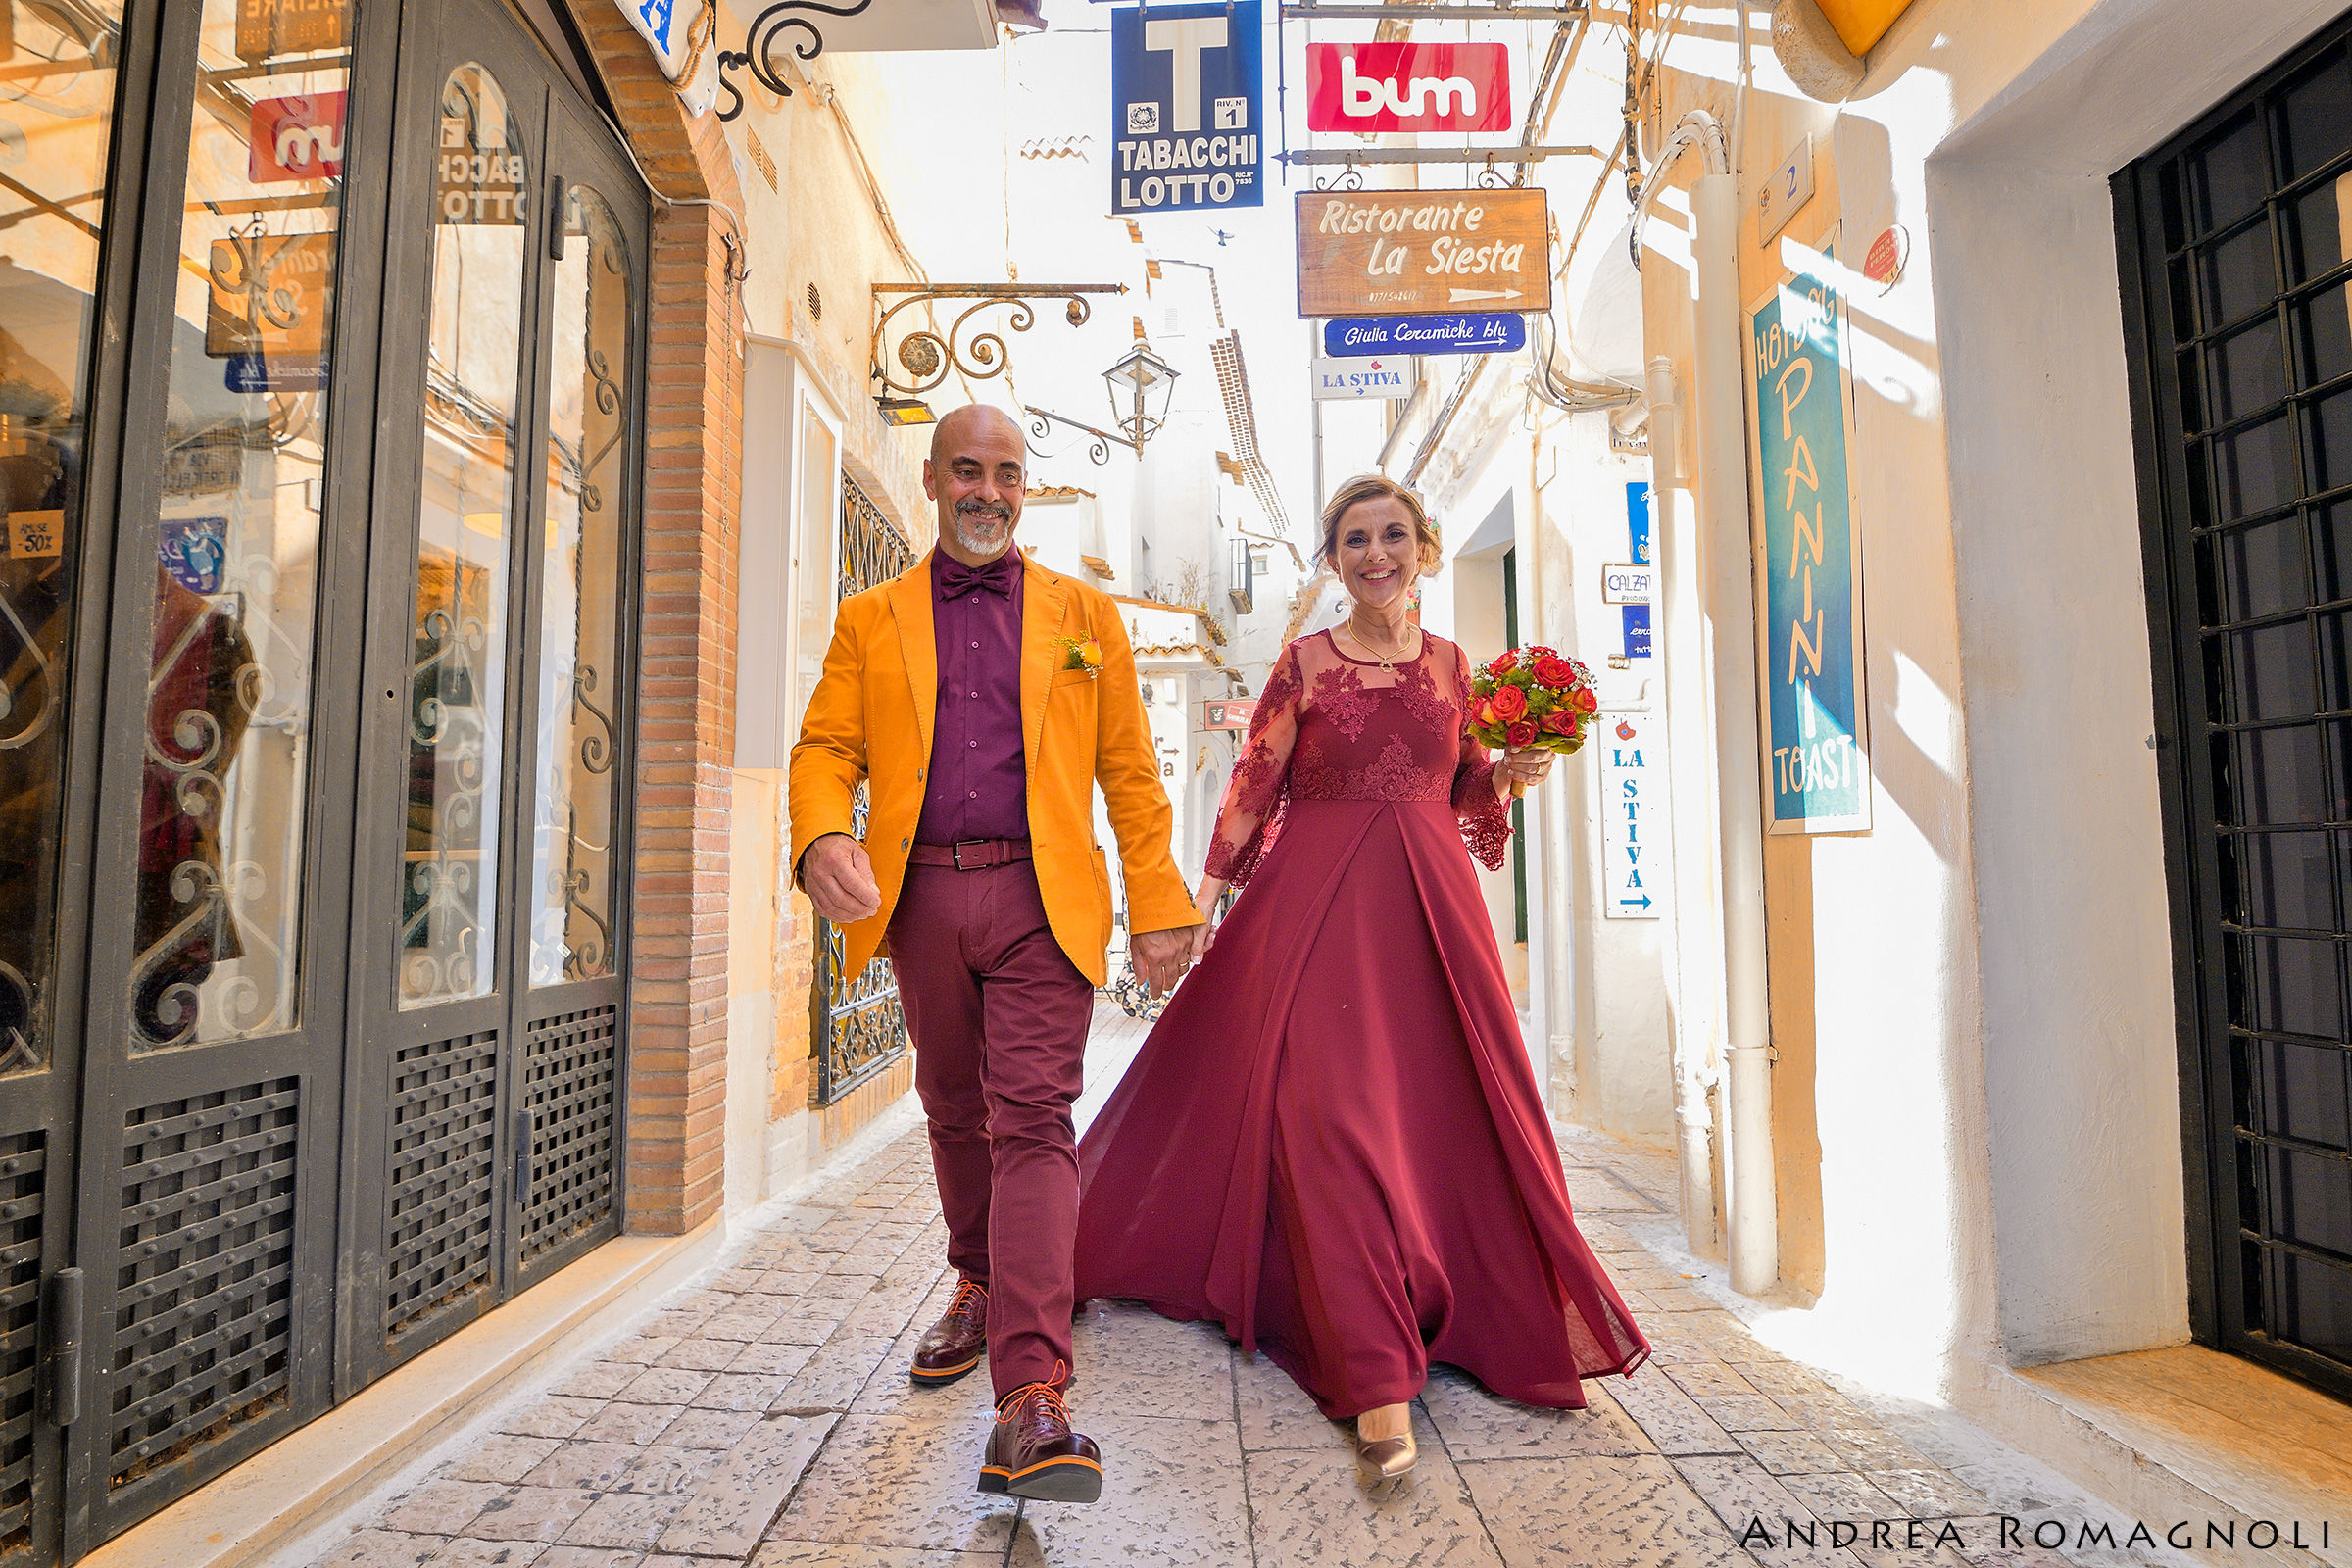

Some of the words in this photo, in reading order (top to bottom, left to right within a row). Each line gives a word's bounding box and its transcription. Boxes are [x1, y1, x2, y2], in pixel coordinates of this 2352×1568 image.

[1145, 16, 1228, 132] T
[1341, 56, 1477, 117] bum
[1225, 108, 1237, 126] 1
[1118, 134, 1257, 172] TABACCHI
[1120, 172, 1235, 208] LOTTO
[1786, 165, 1797, 202] 2
[1319, 200, 1484, 234] Ristorante
[1367, 238, 1408, 275] La
[1425, 236, 1524, 275] Siesta
[1393, 319, 1474, 342] Ceramiche
[1482, 320, 1508, 338] blu
[1323, 374, 1346, 388] LA
[1350, 371, 1402, 387] STIVA
[1613, 749, 1645, 767] LA
[1773, 734, 1853, 795] TOAST
[1623, 779, 1643, 888] STIVA
